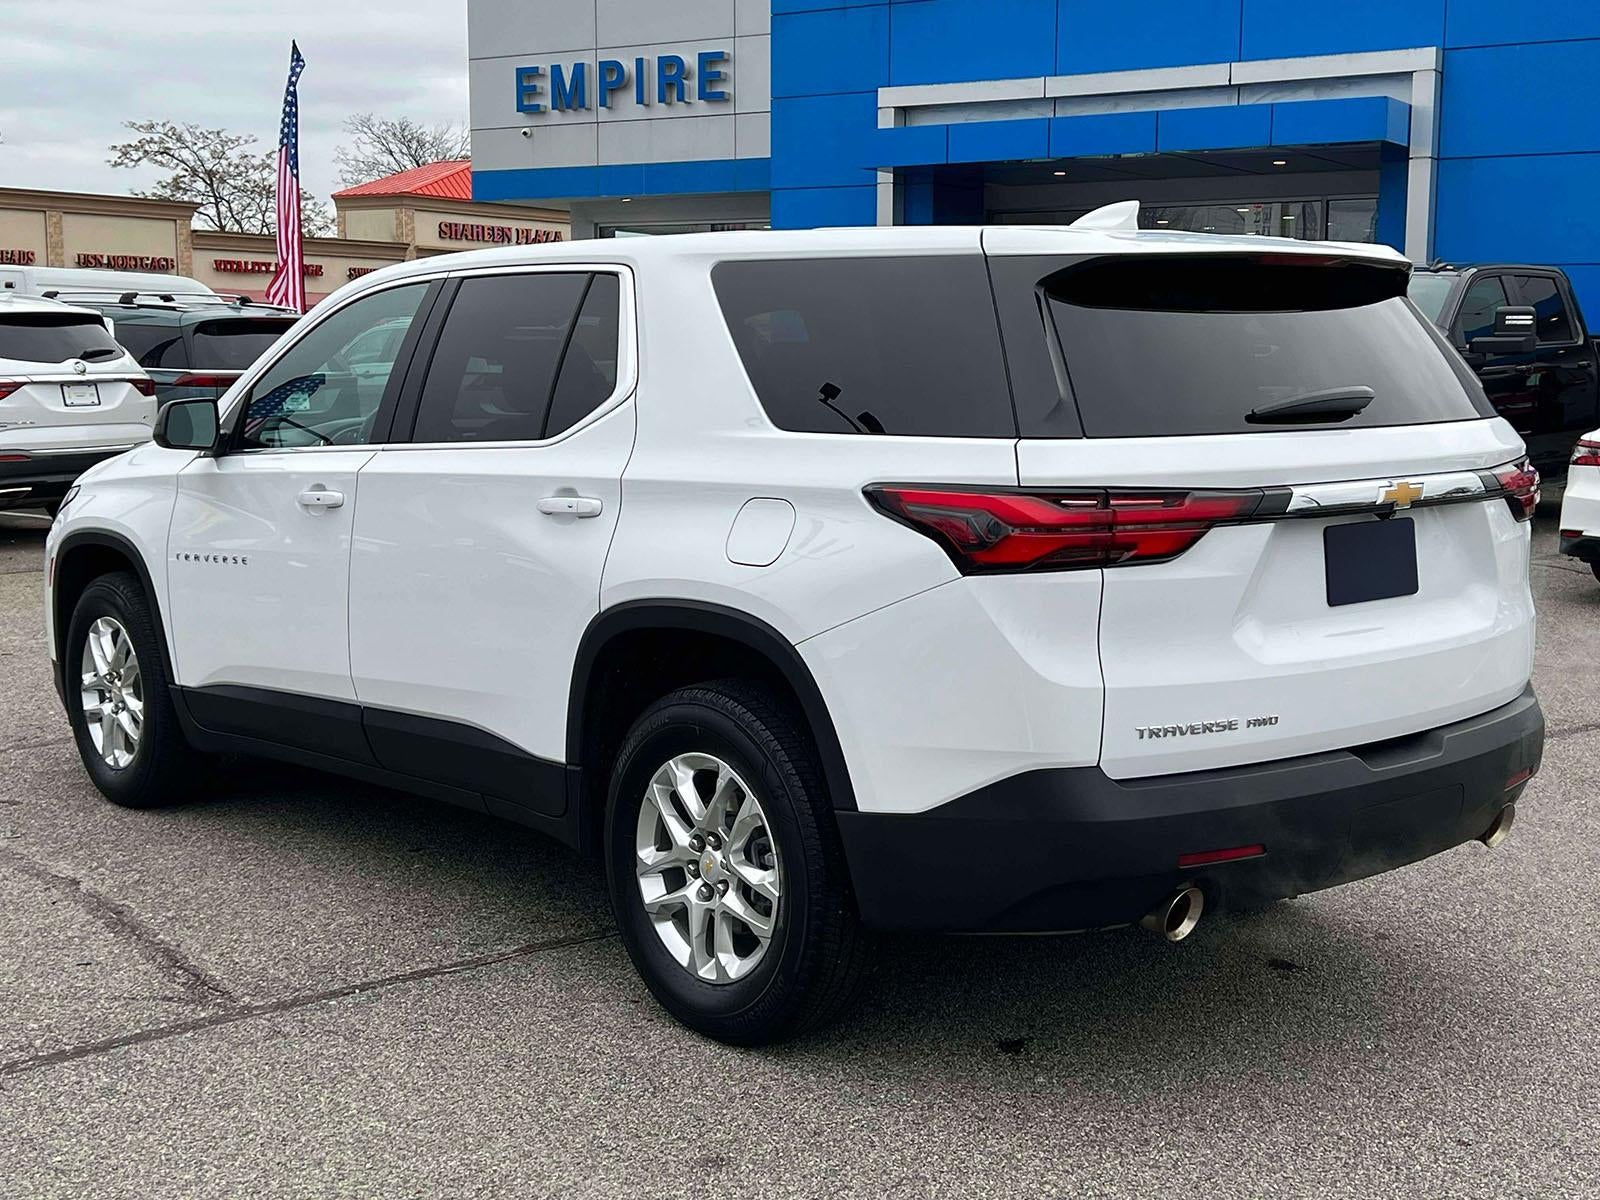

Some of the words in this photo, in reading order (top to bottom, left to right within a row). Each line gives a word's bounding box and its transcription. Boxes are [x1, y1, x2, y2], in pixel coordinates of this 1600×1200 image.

[515, 51, 730, 113] EMPIRE
[438, 221, 513, 243] SHAHEEN
[515, 228, 564, 245] PLAZA
[106, 254, 175, 271] MORTGAGE
[214, 259, 272, 274] VITALITY
[176, 553, 248, 565] TRAVERSE
[1135, 718, 1241, 740] TRAVERSE
[1246, 715, 1279, 729] AWD
